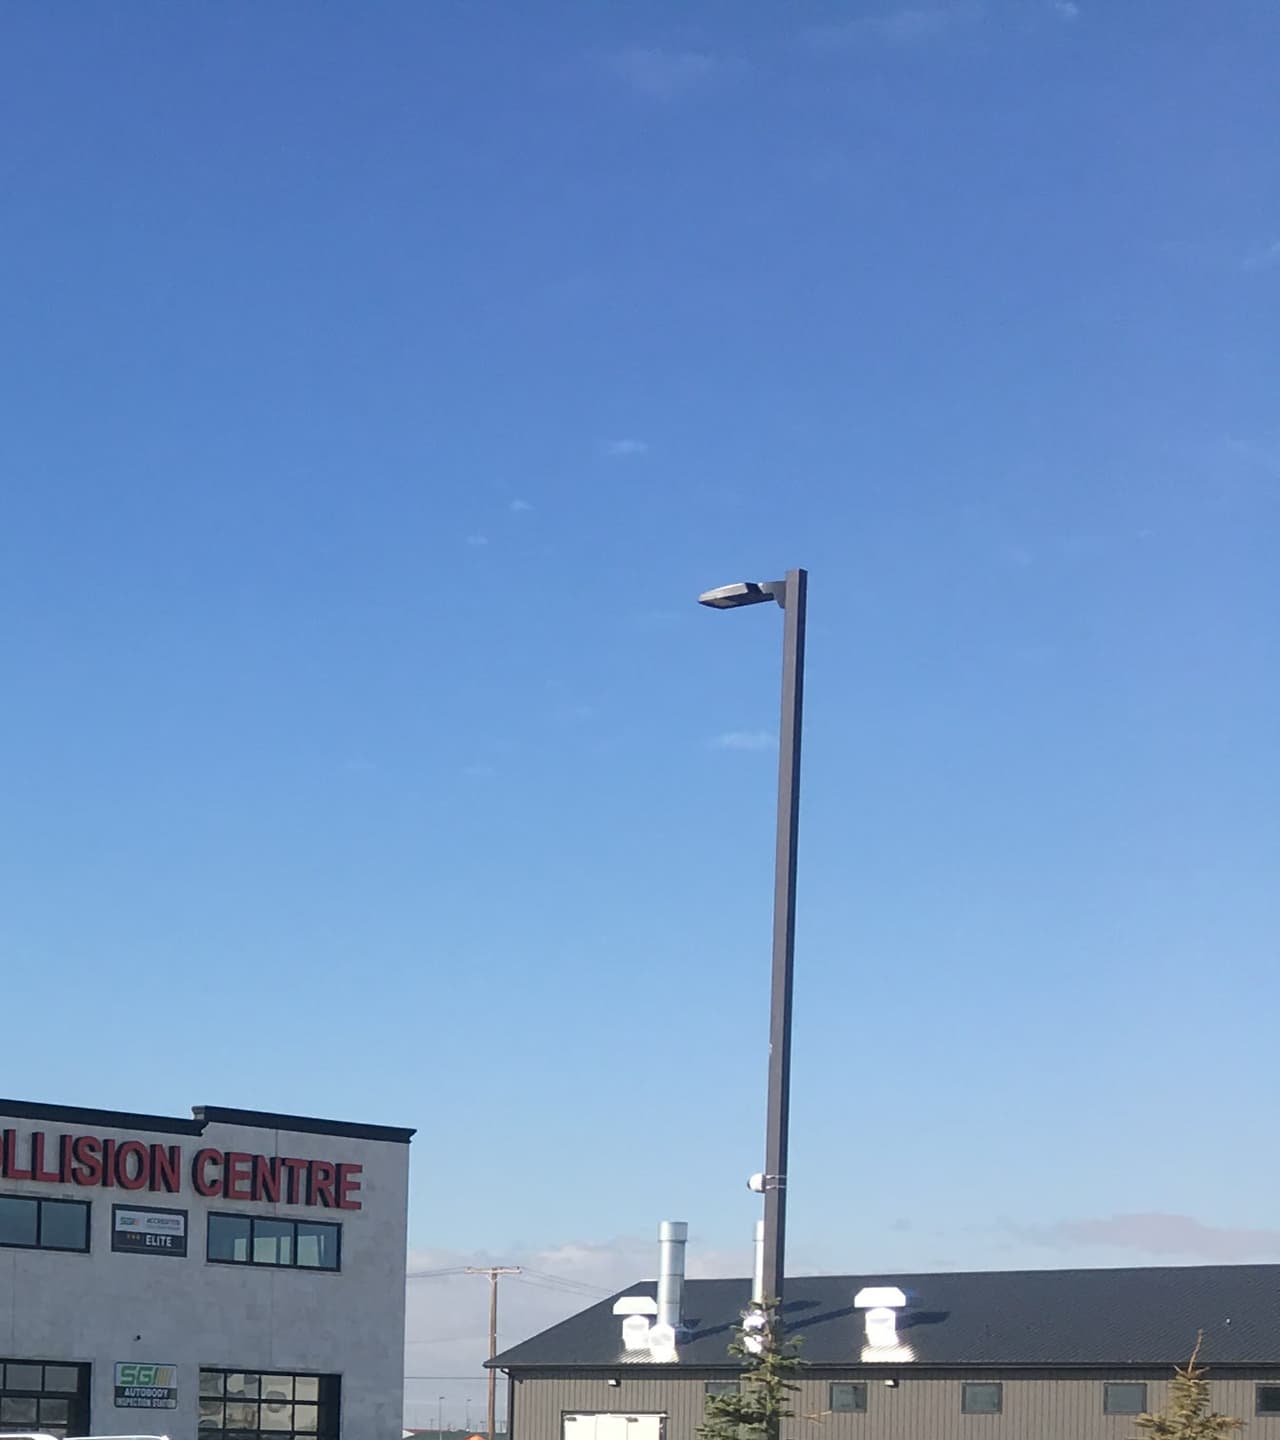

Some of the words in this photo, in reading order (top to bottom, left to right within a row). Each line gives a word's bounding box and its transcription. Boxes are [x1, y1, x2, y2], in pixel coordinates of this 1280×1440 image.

[192, 1148, 364, 1211] CENTRE
[145, 1234, 173, 1247] ELITE
[119, 1365, 159, 1386] SGI
[124, 1387, 169, 1398] AUTOBODY
